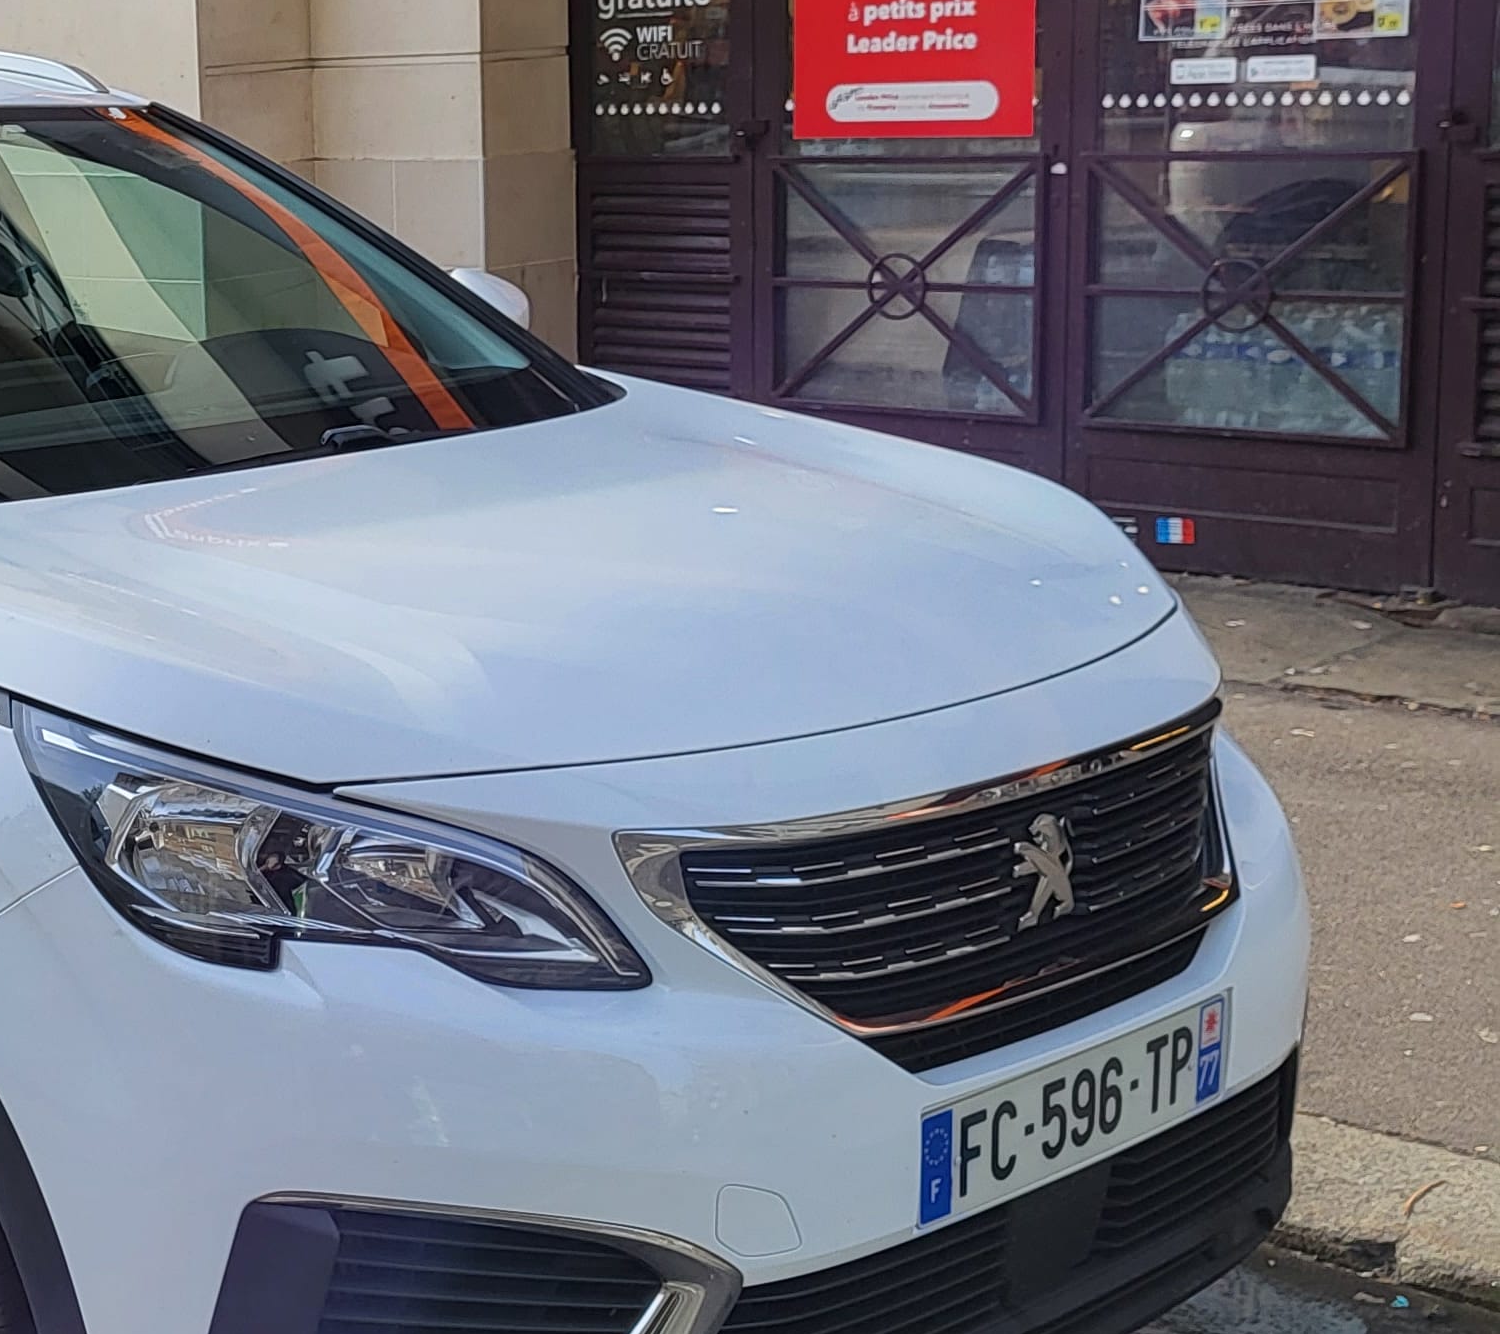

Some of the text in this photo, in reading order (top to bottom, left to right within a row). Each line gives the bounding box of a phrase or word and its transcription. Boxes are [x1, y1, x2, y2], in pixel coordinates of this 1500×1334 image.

[848, 1, 859, 22] à
[636, 24, 674, 43] WIFI
[846, 28, 978, 54] Leader Price
[636, 40, 703, 61] GRATUIT
[1198, 1049, 1220, 1092] 77
[958, 1025, 1194, 1198] FC-596-TP
[930, 1177, 942, 1204] F
